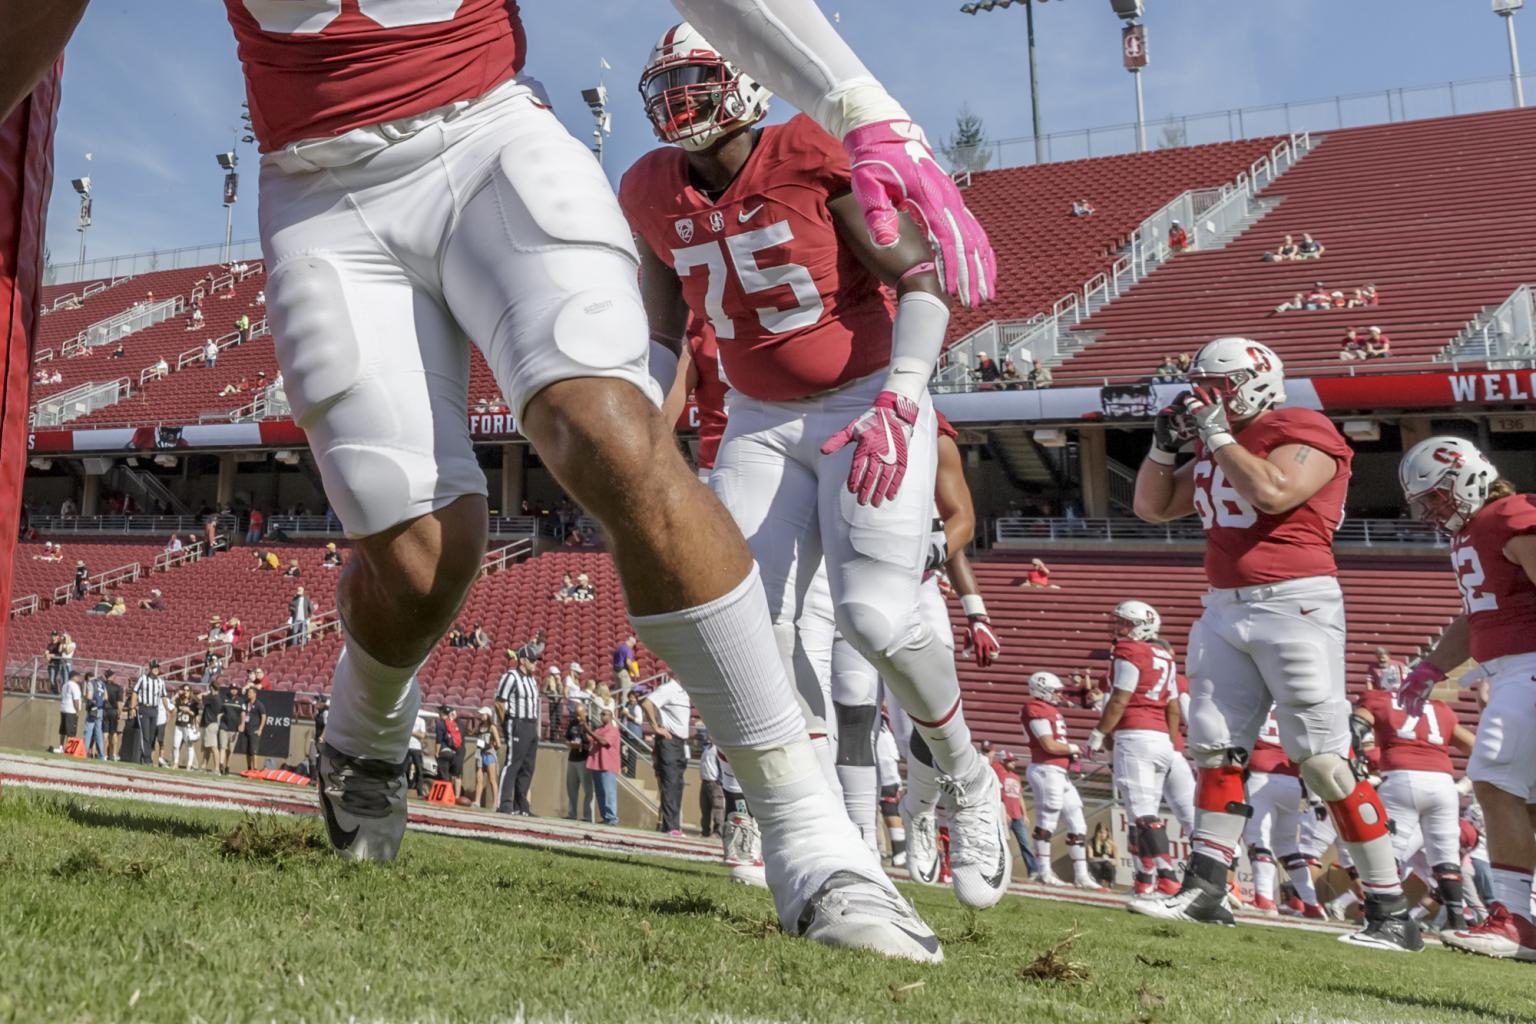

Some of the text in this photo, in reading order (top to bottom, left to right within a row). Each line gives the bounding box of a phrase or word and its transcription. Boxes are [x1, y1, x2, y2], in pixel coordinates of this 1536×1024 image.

[670, 219, 825, 340] 75
[1193, 460, 1258, 530] 66
[66, 739, 80, 752] 20
[431, 783, 445, 800] 10
